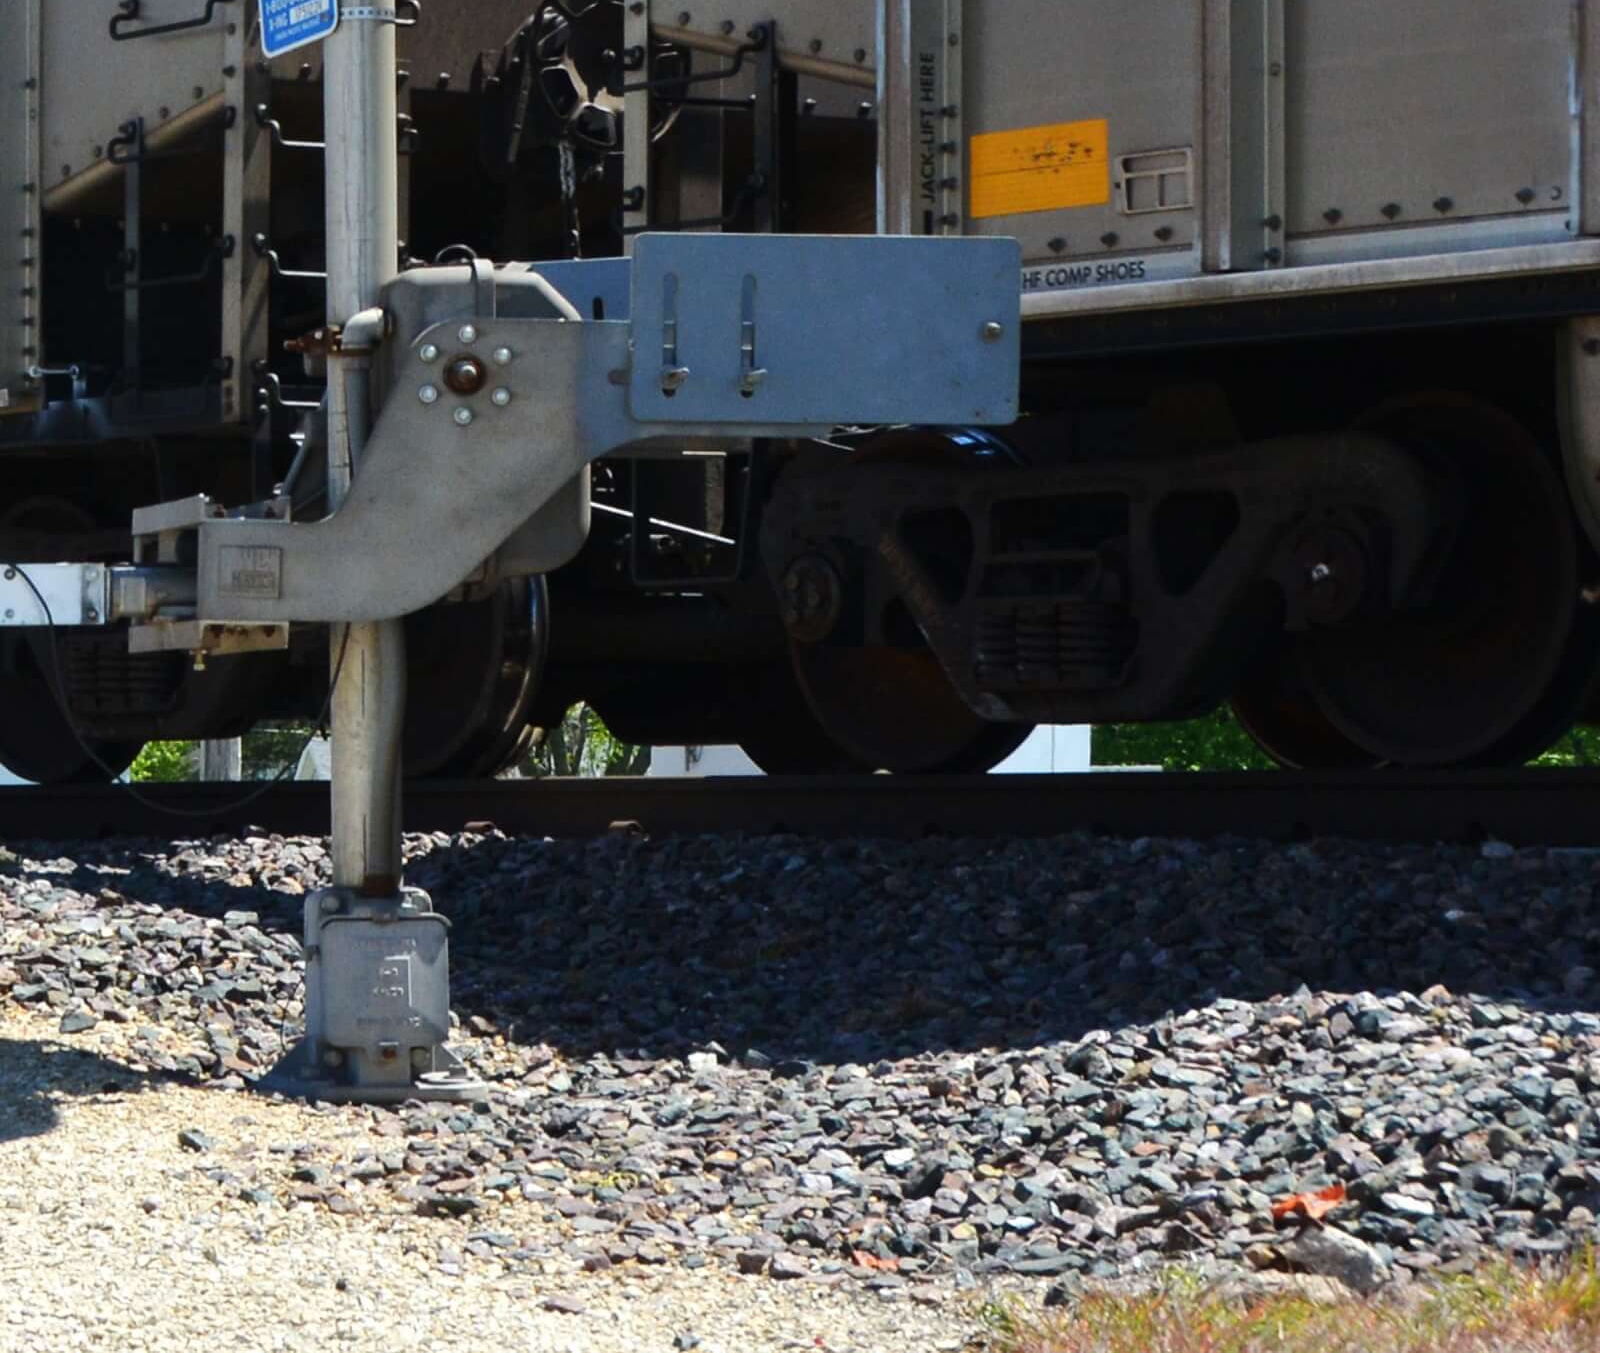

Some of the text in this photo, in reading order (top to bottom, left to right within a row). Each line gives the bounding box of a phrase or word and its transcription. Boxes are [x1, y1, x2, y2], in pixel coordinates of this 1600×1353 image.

[920, 52, 936, 102] HERE
[1022, 260, 1146, 289] HF COMP SHOES
